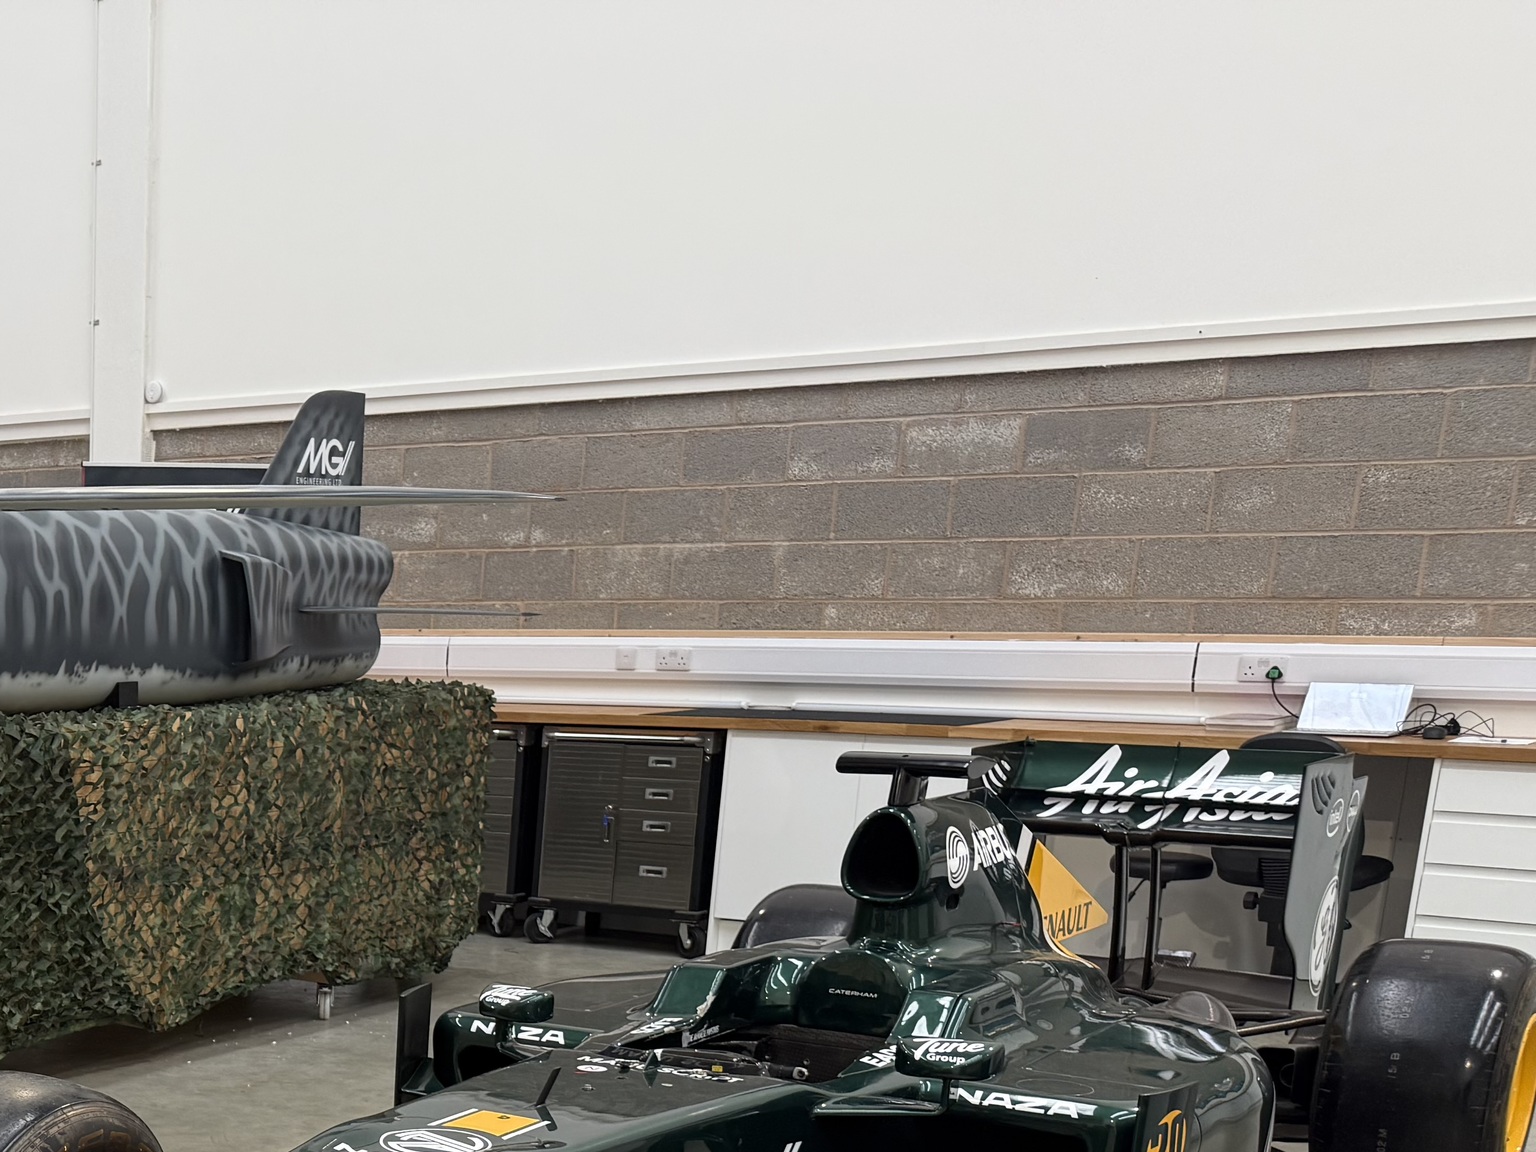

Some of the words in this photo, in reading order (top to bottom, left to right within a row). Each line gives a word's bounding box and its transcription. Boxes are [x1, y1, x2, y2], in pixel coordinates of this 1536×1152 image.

[971, 822, 1017, 872] AIRBU
[1043, 901, 1093, 939] NAULT
[828, 987, 878, 999] CATERHAM
[470, 1019, 566, 1046] NZA
[913, 1037, 986, 1061] Tune
[926, 1052, 967, 1066] Group
[956, 1088, 1080, 1120] NAZA
